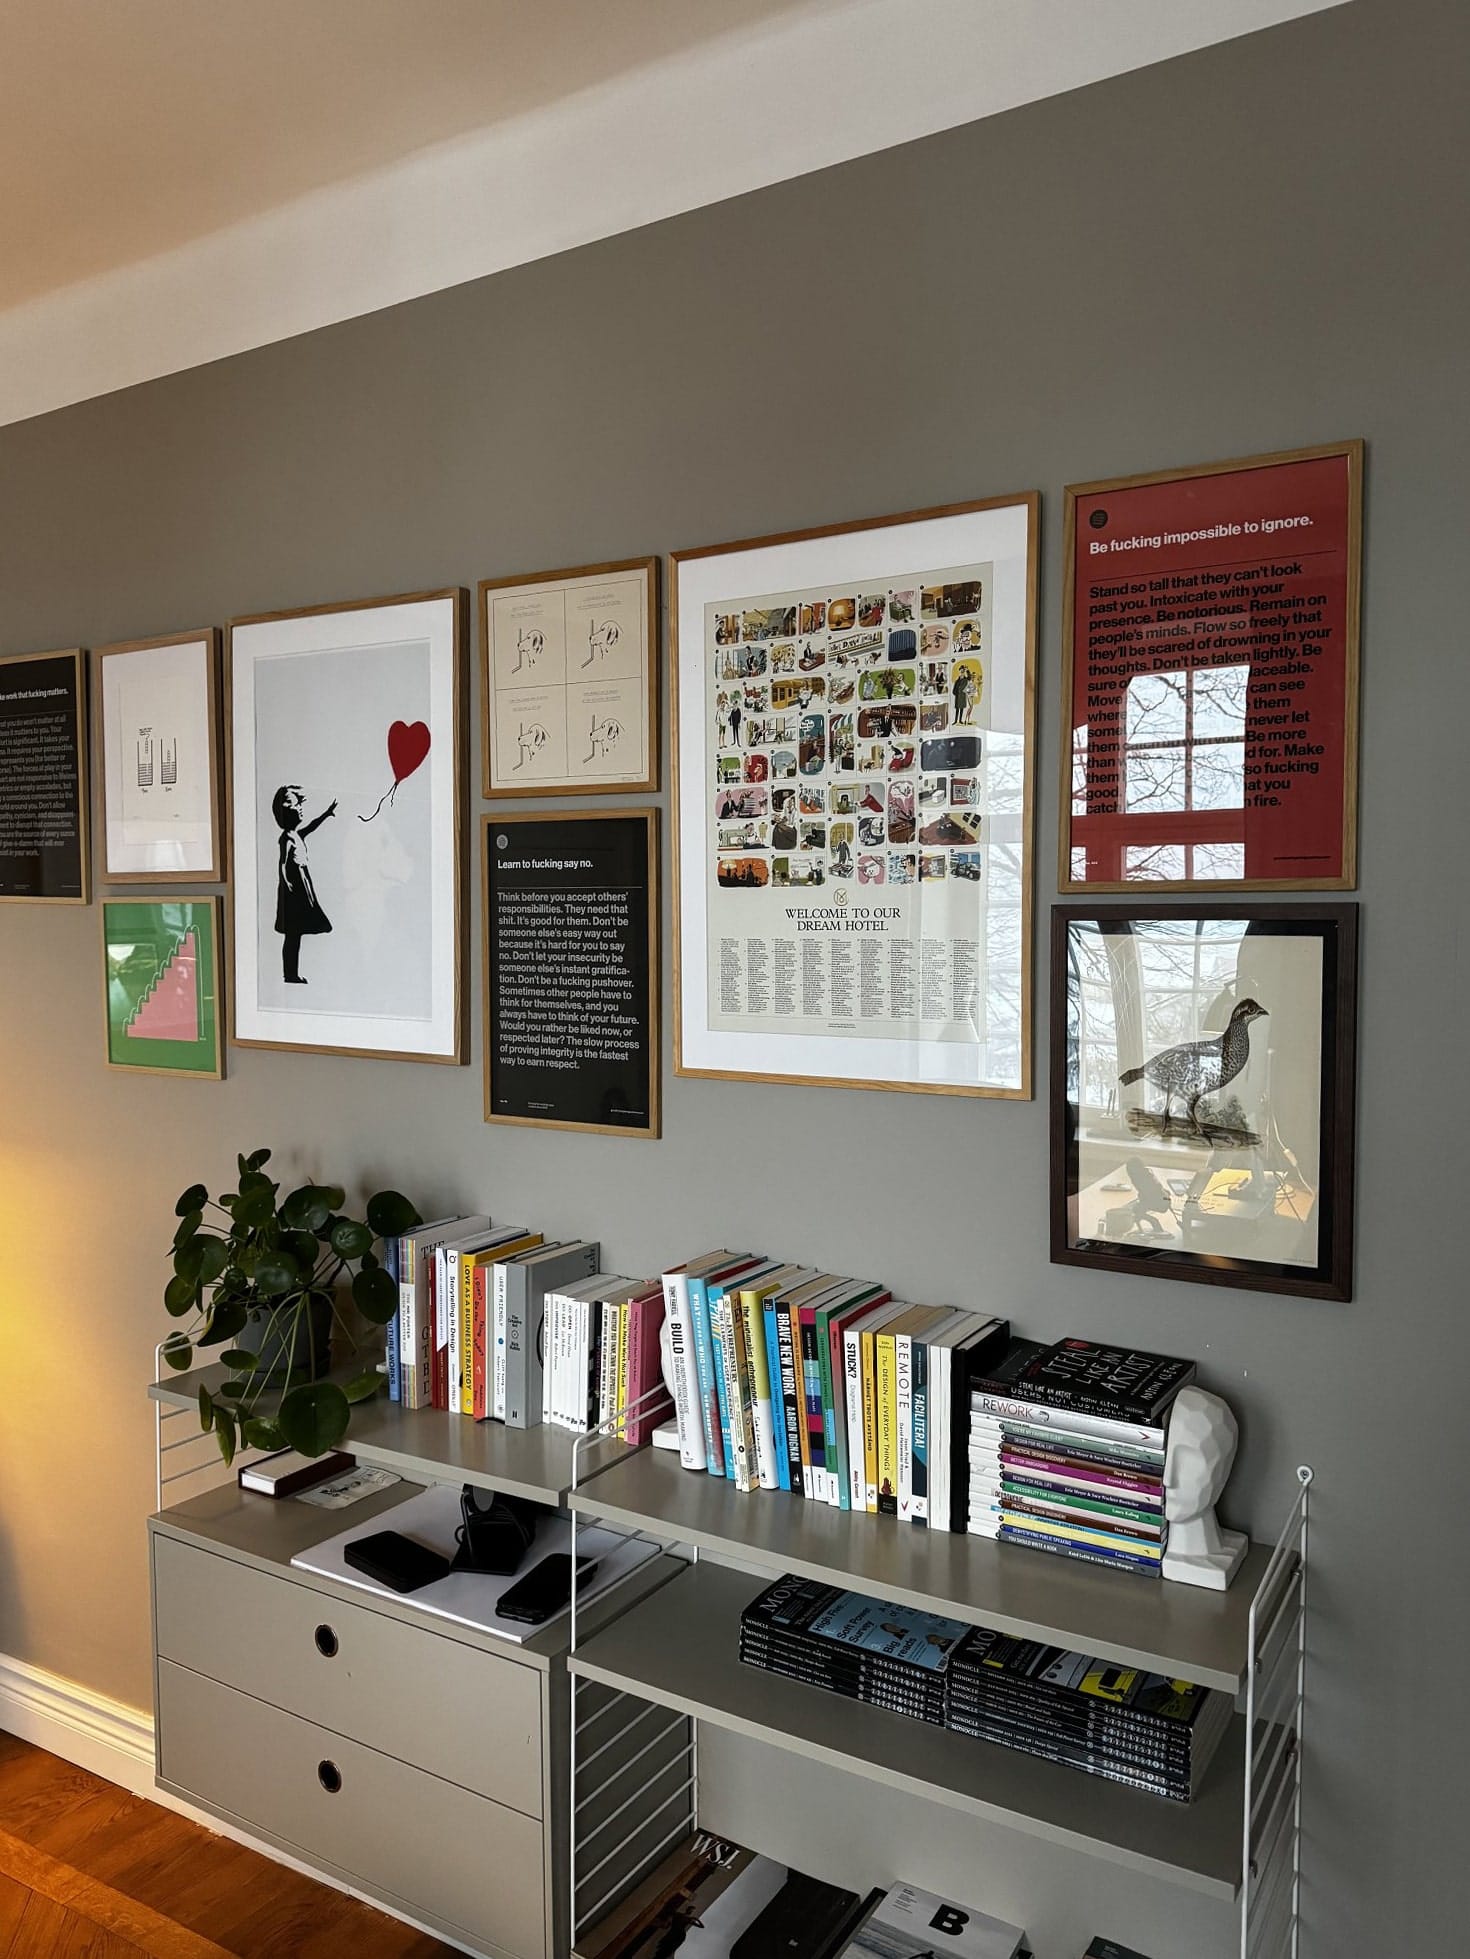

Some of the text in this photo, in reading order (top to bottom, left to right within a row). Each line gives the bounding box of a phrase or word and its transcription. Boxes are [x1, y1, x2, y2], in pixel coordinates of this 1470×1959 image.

[1090, 517, 1313, 553] Be fucking impossible to ignore.
[1090, 563, 1302, 597] Stand so tall that they can't look
[1090, 584, 1284, 616] past you. Intoxicate with your
[1090, 597, 1327, 632] presence. Be notorious. Remain on
[1089, 612, 1322, 647] people's minds. Flow so freely that
[1249, 711, 1310, 725] never let
[1247, 730, 1306, 741] Be more
[1265, 761, 1319, 774] fucking
[1254, 795, 1281, 806] fire.
[498, 860, 520, 868] Learn
[532, 859, 562, 869] fucking
[564, 861, 578, 869] say
[498, 892, 628, 902] Think before you accept others'
[498, 904, 628, 915] responsibilities. They need that
[786, 908, 901, 919] WELCOME TO OUR
[499, 916, 628, 926] shit. It's good for them. Don't be
[797, 921, 888, 931] DREAM HOTEL
[500, 1044, 628, 1060] of proving integrity is the fastest
[500, 1057, 515, 1066] way
[546, 1060, 580, 1069] respect.
[448, 1275, 456, 1317] Storytelling
[464, 1287, 470, 1300] AS
[670, 1322, 684, 1353] BUILD
[743, 1320, 754, 1357] minimalist
[776, 1312, 795, 1396] BRAVE NEW WORK
[846, 1342, 856, 1378] STUCK?
[1041, 1347, 1101, 1379] STEAL
[897, 1342, 909, 1408] REMOTE
[1075, 1352, 1123, 1385] LIKE AN
[1100, 1354, 1154, 1393] ARTIST
[981, 1397, 1034, 1419] REWORK
[912, 1393, 924, 1448] FACILITERA!
[785, 1405, 800, 1462] AARON DIGNAN
[812, 1616, 832, 1631] High
[837, 1623, 854, 1638] Soft
[849, 1620, 875, 1643] Survey
[883, 1640, 901, 1654] Big
[898, 1638, 918, 1657] reads
[951, 1659, 979, 1673] MONOCLE
[951, 1672, 979, 1685] MONOCLE
[950, 1714, 978, 1726] MONOCLE
[690, 1834, 740, 1869] WSJ.
[928, 1903, 970, 1936] B
